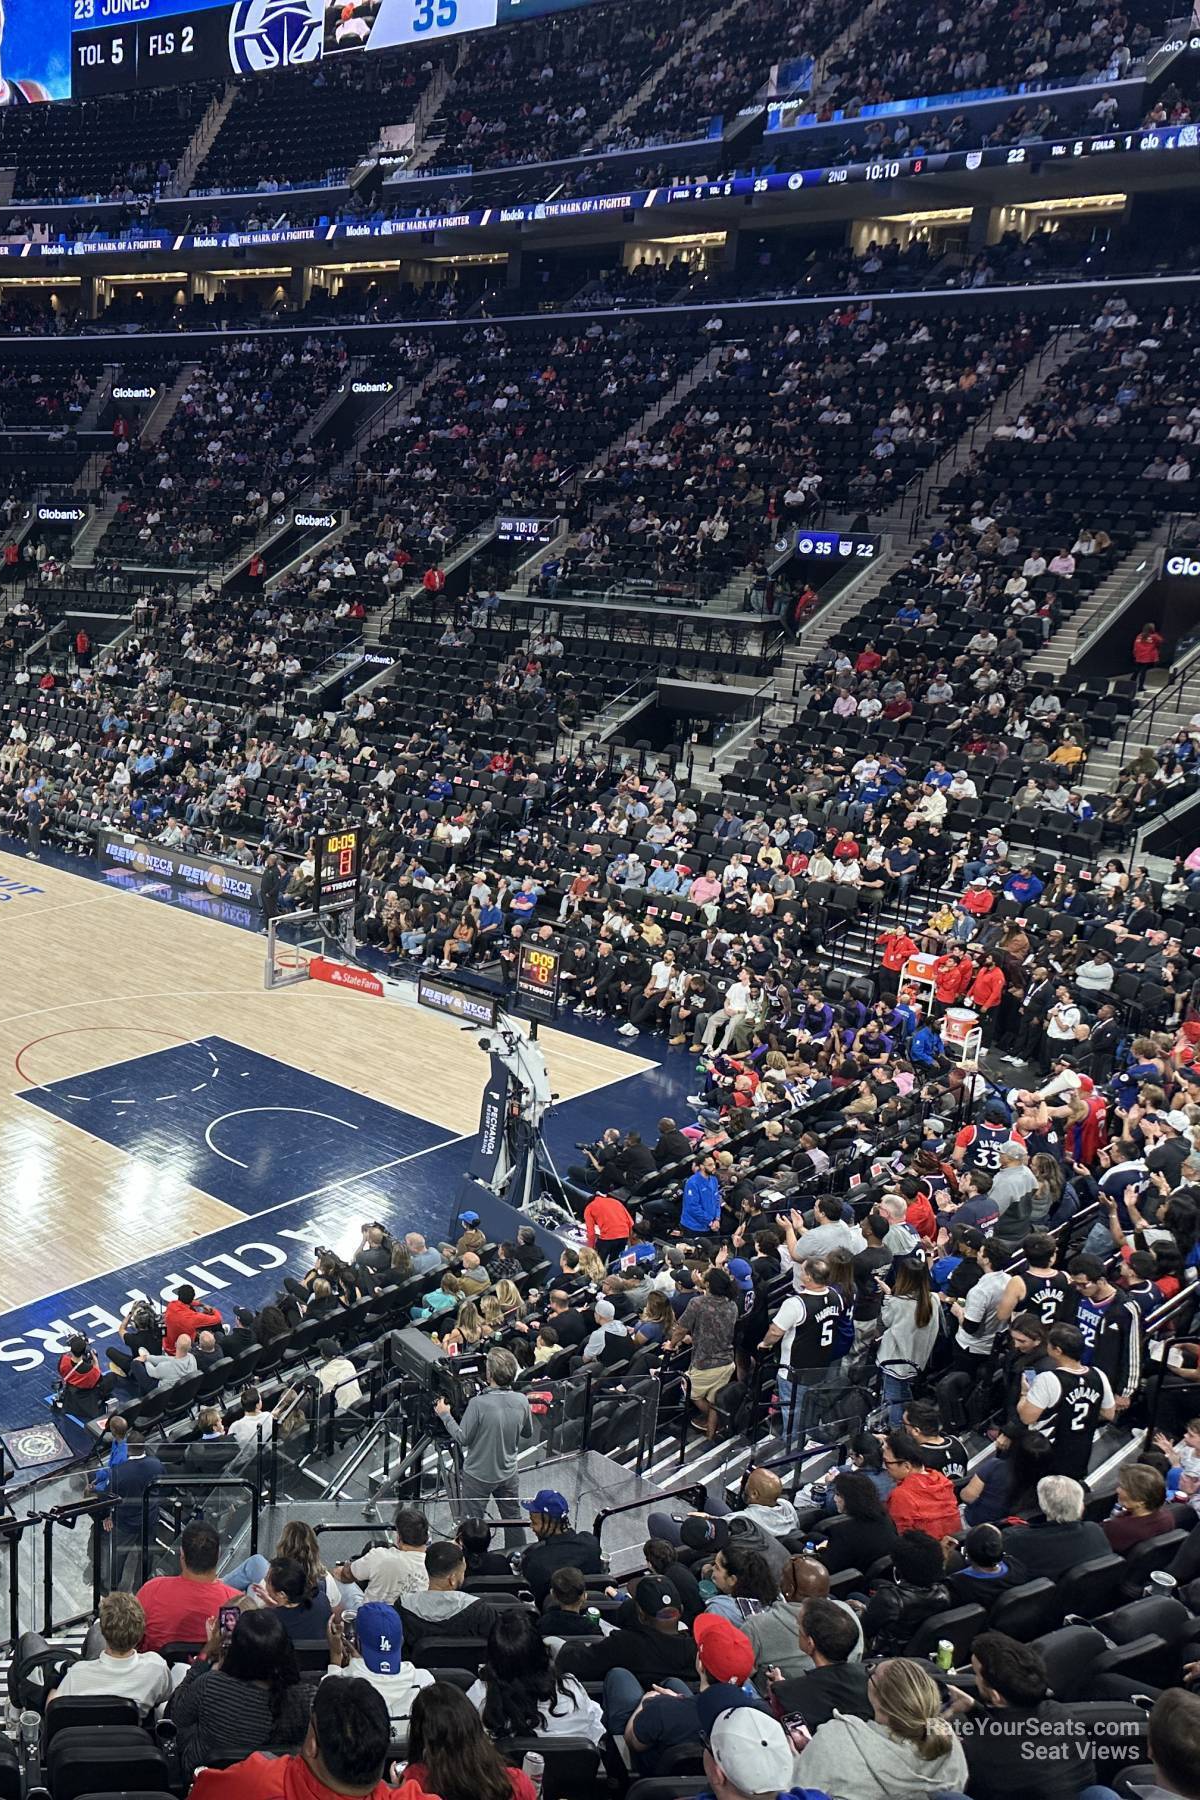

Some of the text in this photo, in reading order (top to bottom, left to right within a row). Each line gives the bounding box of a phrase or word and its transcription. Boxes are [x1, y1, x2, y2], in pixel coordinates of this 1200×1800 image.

[74, 0, 94, 20] 23
[412, 0, 457, 33] 35
[78, 38, 124, 67] TOL 5
[149, 26, 194, 58] FLS 2
[1007, 148, 1026, 164] 22
[1073, 141, 1083, 156] 5
[724, 184, 731, 195] 5
[753, 179, 768, 192] 35
[828, 169, 848, 182] 2ND
[864, 161, 900, 180] 10:10
[914, 160, 922, 173] 8
[500, 209, 524, 222] Modelo
[545, 204, 559, 216] THE
[560, 202, 581, 215] MARK
[599, 196, 631, 210] FIGHTER
[346, 225, 370, 237] Modelo
[392, 222, 405, 233] THE
[407, 220, 427, 231] MARK
[443, 215, 470, 227] FIGHTER
[41, 244, 64, 255] Modelo
[84, 243, 96, 253] THE
[97, 242, 116, 252] MARK
[134, 240, 161, 250] FIGHTER
[193, 236, 218, 248] Modelo
[239, 235, 252, 245] THE
[253, 234, 271, 244] MARK
[287, 230, 314, 241] FIGHTER
[112, 388, 150, 398] Globant
[351, 383, 387, 393] Globant
[38, 508, 79, 520] Globant
[294, 514, 330, 527] Globant
[515, 522, 538, 533] 10:10
[815, 542, 874, 557] 35 22
[328, 834, 355, 852] 10:09
[105, 843, 137, 861] IBEW
[145, 854, 174, 872] NECA
[339, 849, 352, 876] 8
[178, 863, 210, 883] IBEW
[221, 877, 253, 896] NECA
[331, 879, 358, 892] TISSOT
[530, 951, 555, 969] 10:09
[539, 966, 548, 983] 8
[528, 984, 554, 997] TISSOT
[421, 986, 454, 1005] IBEW
[463, 1001, 493, 1018] NECA
[485, 1105, 499, 1155] PECHANGA
[481, 1130, 489, 1154] CASINO
[973, 1148, 1002, 1170] 33
[814, 1305, 840, 1323] HARRELL
[1040, 1301, 1057, 1325] 2
[820, 1319, 834, 1347] 5
[1065, 1386, 1100, 1405] LEONARD
[1071, 1402, 1090, 1431] 2
[380, 1635, 392, 1651] LA
